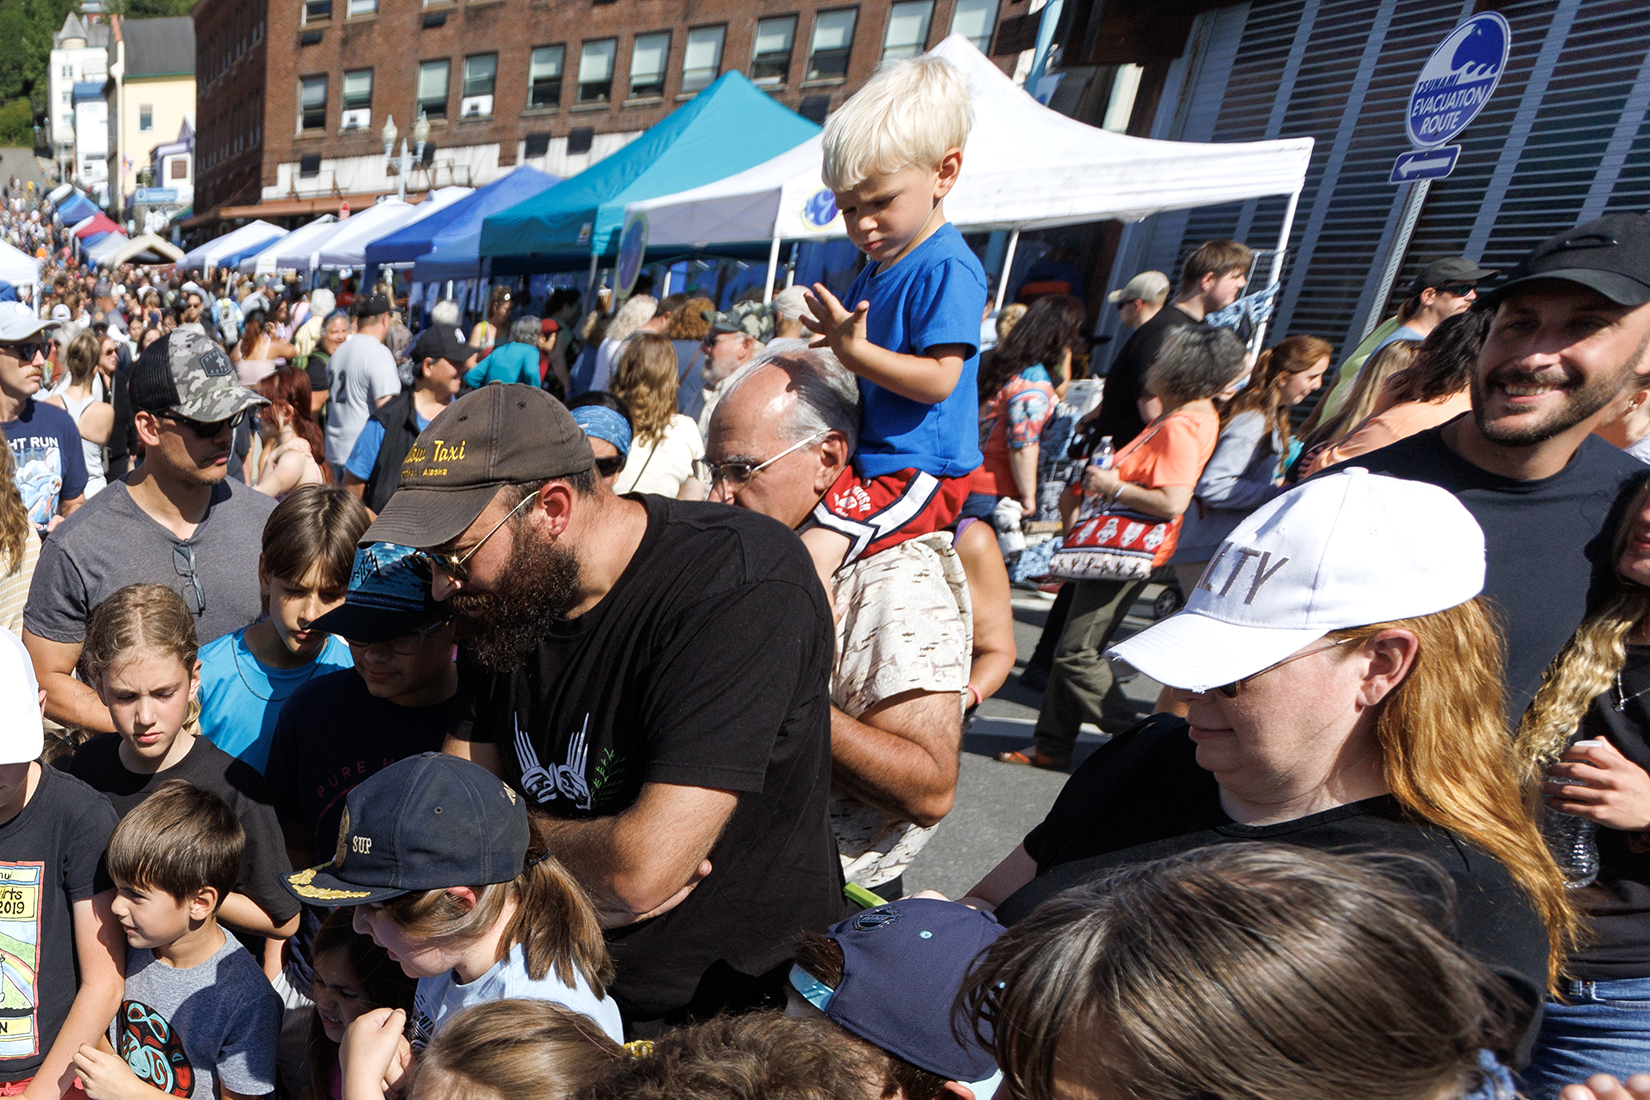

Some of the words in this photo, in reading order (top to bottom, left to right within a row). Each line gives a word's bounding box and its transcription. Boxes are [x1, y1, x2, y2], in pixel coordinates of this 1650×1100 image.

[1417, 72, 1462, 95] TSUNAMI
[1411, 83, 1489, 118] EVACUATION
[1419, 110, 1462, 136] ROUTE
[29, 436, 60, 448] RUN
[433, 440, 467, 462] Taxi
[421, 467, 448, 477] Alaska
[316, 760, 367, 799] PURE
[352, 835, 372, 855] SUP
